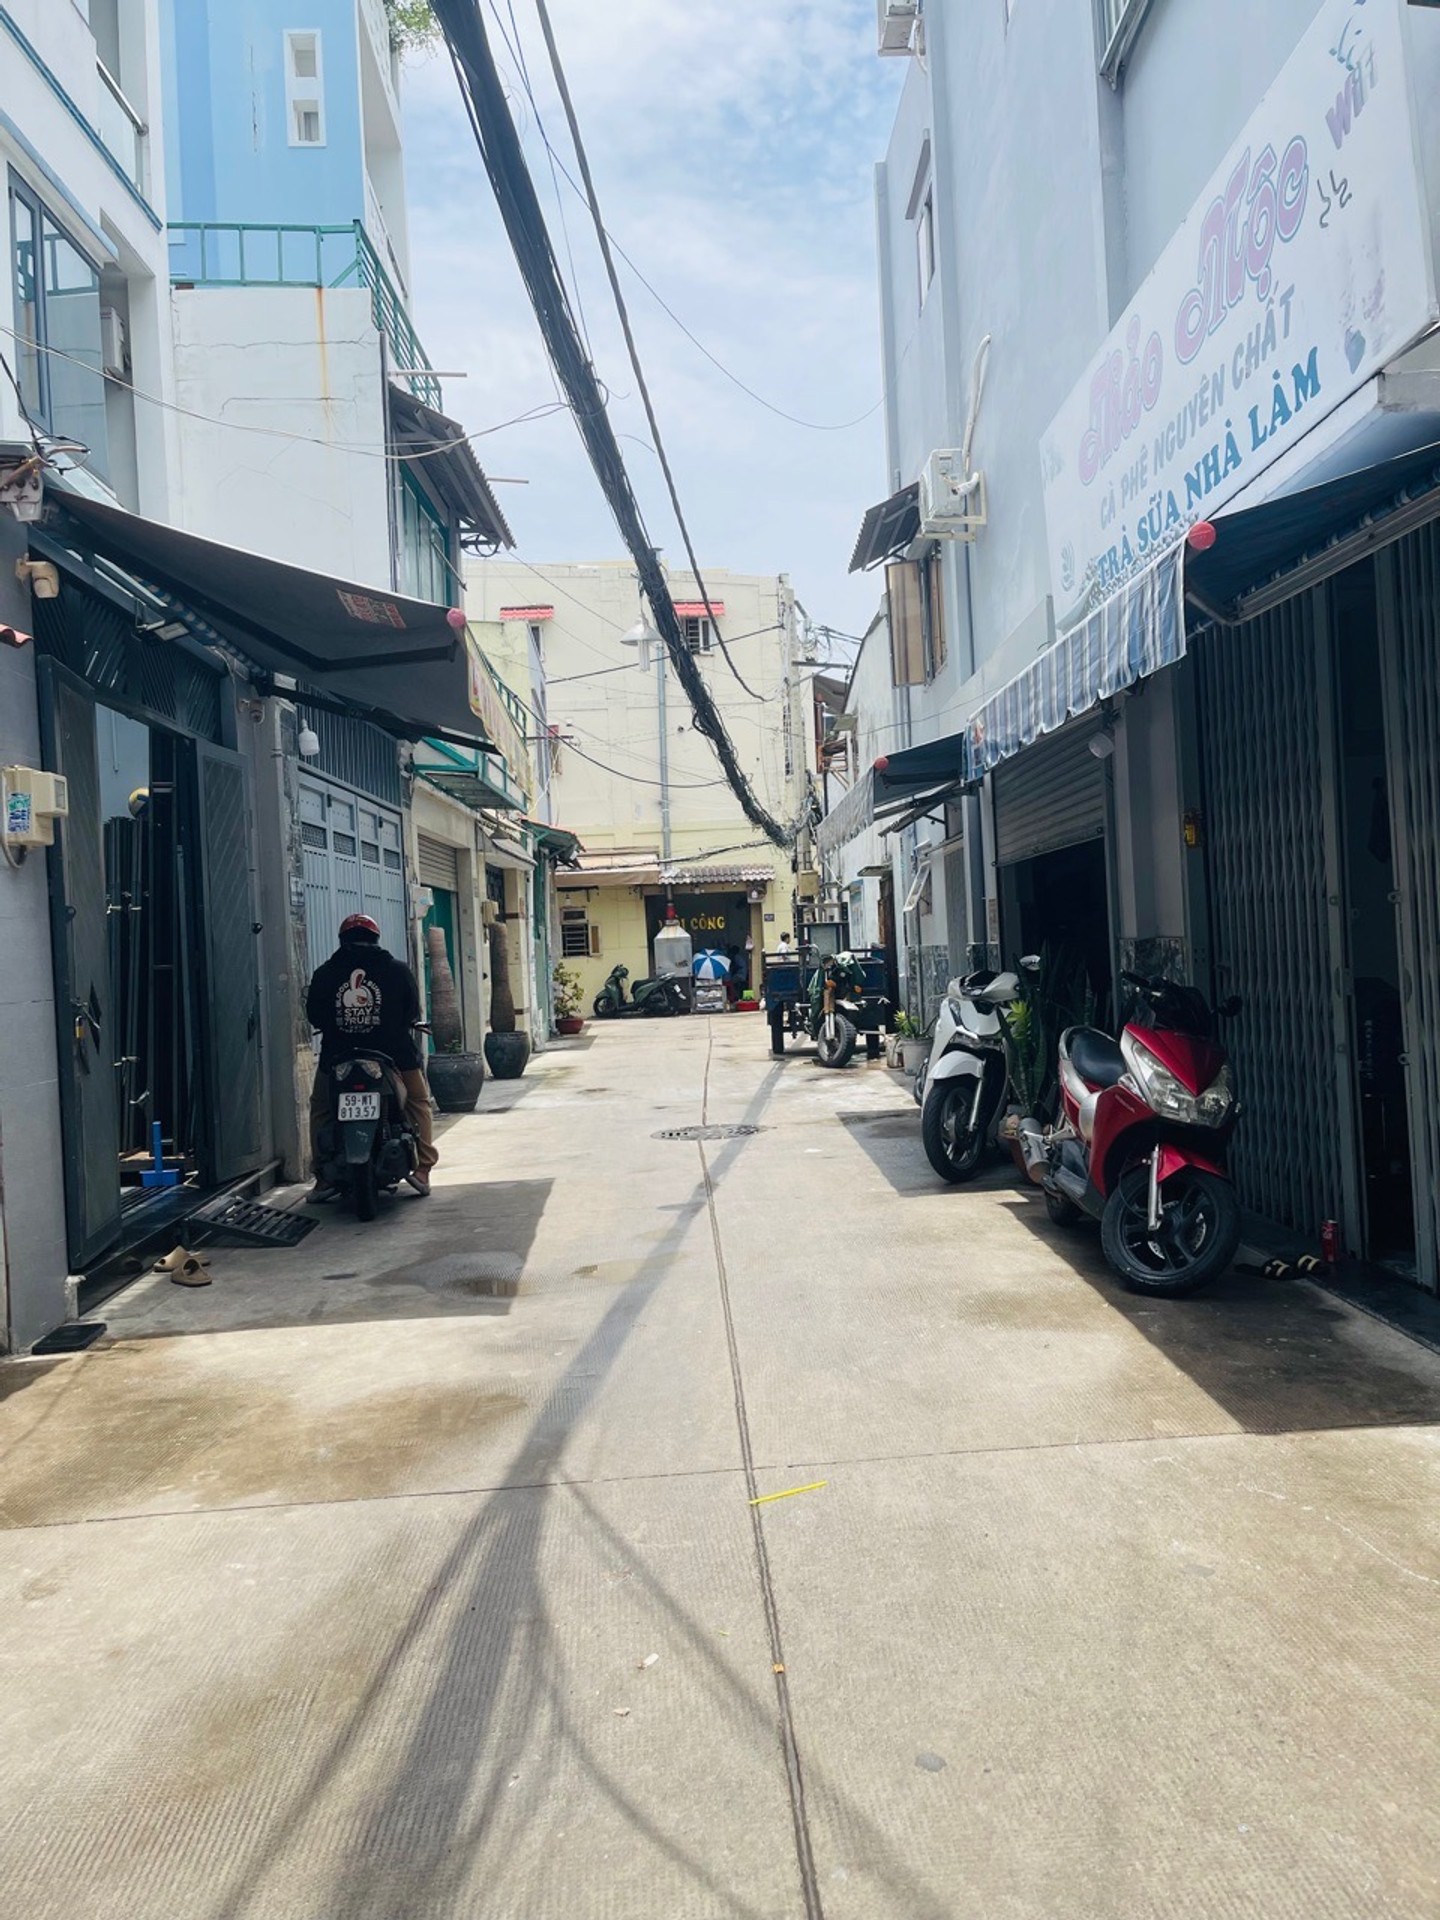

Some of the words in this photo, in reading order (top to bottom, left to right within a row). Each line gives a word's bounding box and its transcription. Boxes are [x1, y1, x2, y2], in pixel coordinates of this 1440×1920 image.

[1175, 134, 1309, 365] Mộc
[1096, 525, 1134, 589] TRÀ
[1136, 487, 1181, 553] SỮA
[1183, 418, 1243, 511] NHÀ
[1248, 345, 1322, 452] LÀM
[1100, 481, 1116, 531] CÀ
[1120, 448, 1149, 509] PHÊ
[1153, 363, 1226, 476] NGUYÊN
[1231, 280, 1295, 391] CHẤT
[690, 913, 725, 930] CÔNG
[344, 1006, 373, 1017] STAY
[344, 1015, 371, 1026] TRUE
